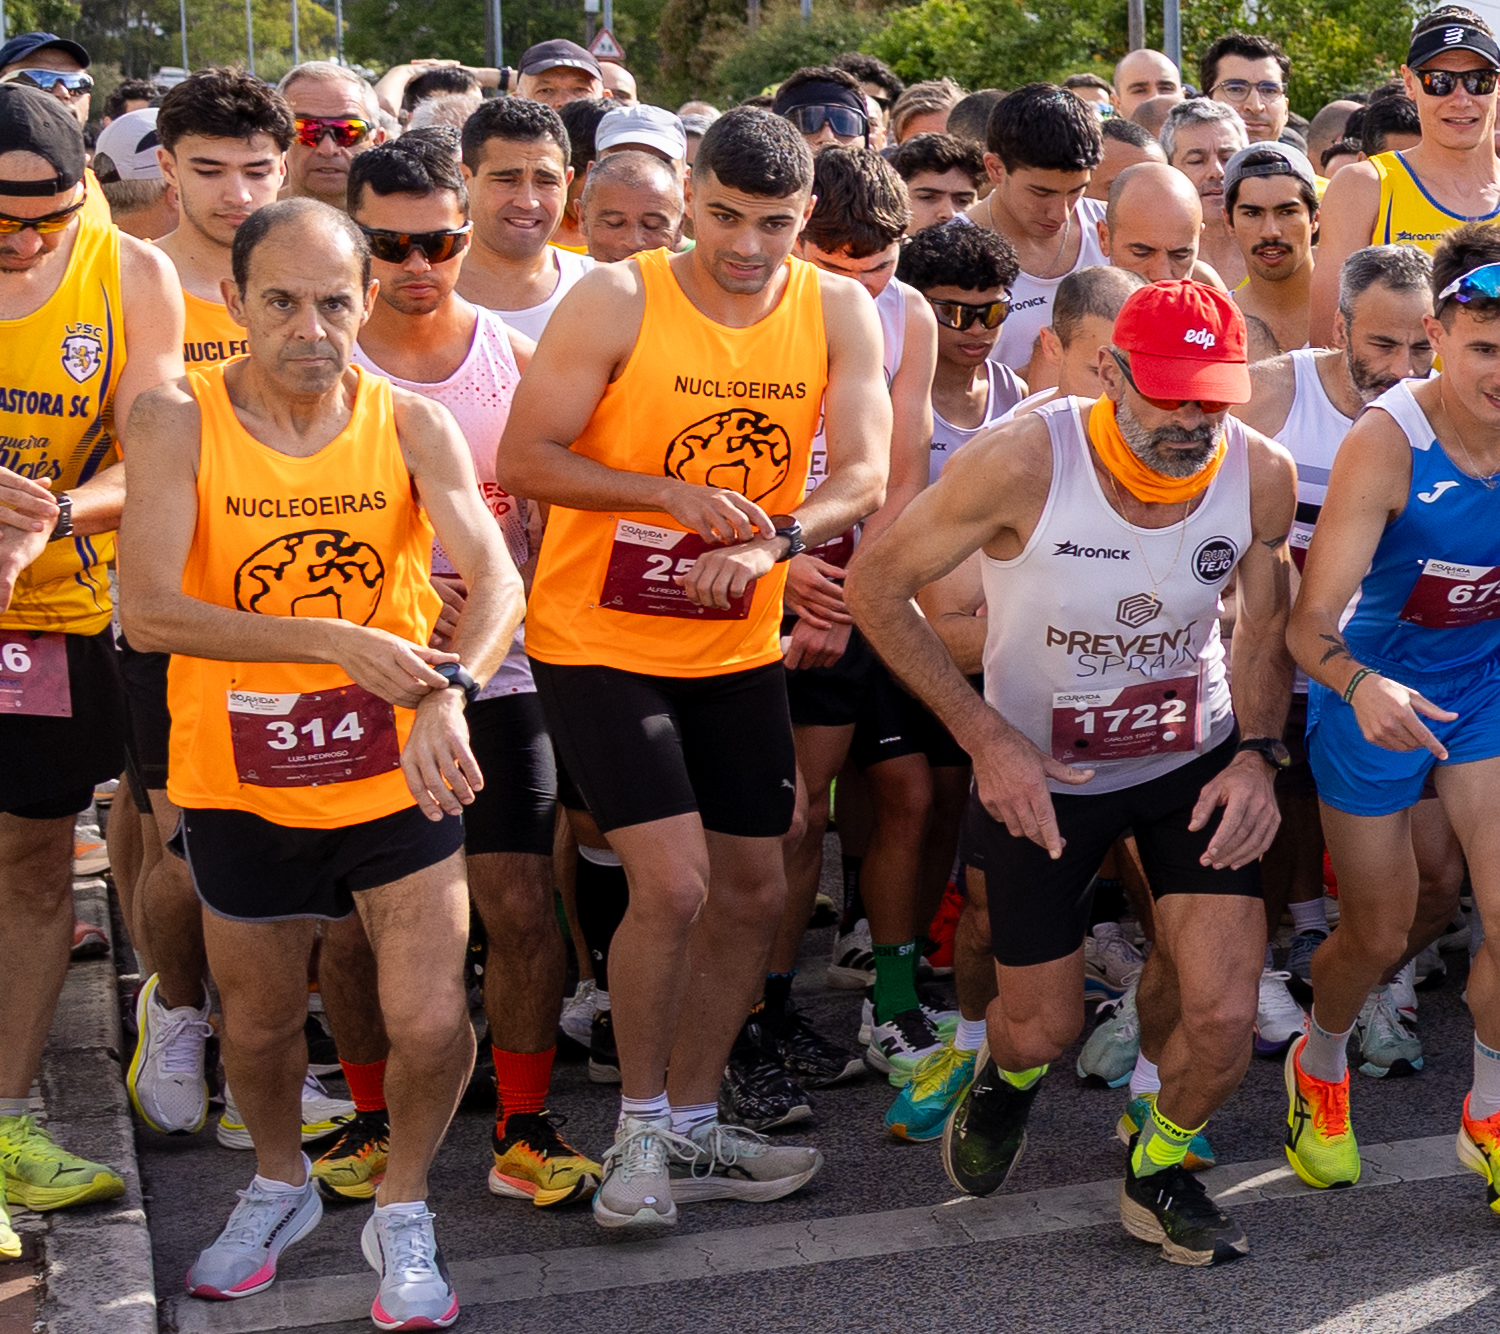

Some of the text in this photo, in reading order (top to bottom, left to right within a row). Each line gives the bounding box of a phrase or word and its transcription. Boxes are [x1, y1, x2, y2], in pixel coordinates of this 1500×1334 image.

[1009, 296, 1047, 314] ronick
[65, 322, 103, 338] LPSC
[1184, 328, 1215, 349] edp
[674, 375, 806, 400] NUCLEOEIRAS
[68, 395, 90, 418] SC
[226, 490, 387, 518] NUCLEOEIRAS
[1052, 540, 1131, 560] Aronick
[1201, 549, 1232, 562] RUN
[641, 553, 698, 582] 25
[1200, 559, 1232, 572] TEJO
[1046, 619, 1198, 657] PREVENT
[0, 642, 32, 673] 6
[1076, 646, 1198, 677] SPRAIN
[1075, 699, 1187, 734] 1722
[265, 711, 365, 750] 314
[1103, 734, 1133, 743] CARLOS
[287, 754, 306, 763] LUIS
[308, 749, 349, 762] PEDROSO
[263, 1207, 298, 1249] KIPRUN
